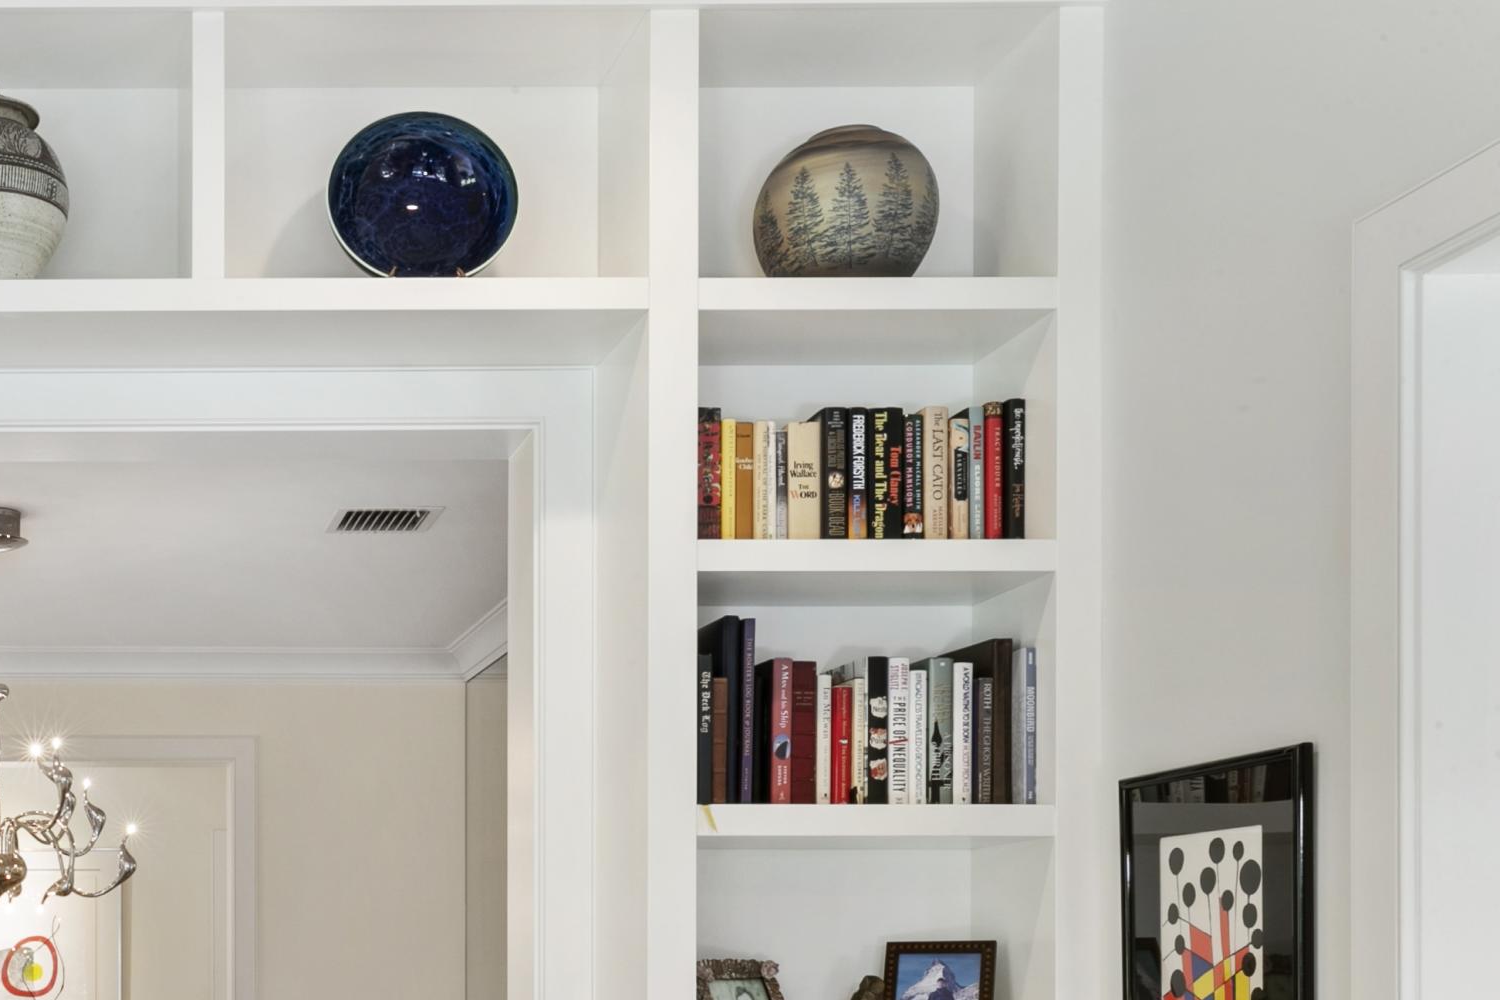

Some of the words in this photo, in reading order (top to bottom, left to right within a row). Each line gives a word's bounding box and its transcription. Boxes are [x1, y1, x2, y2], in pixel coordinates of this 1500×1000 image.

[875, 412, 888, 431] The
[933, 412, 944, 426] The
[852, 415, 865, 455] FREDERICK
[875, 433, 887, 458] Bear
[932, 429, 944, 461] LAST
[875, 460, 888, 479] and
[890, 446, 901, 468] Tom
[852, 456, 865, 490] FORSYTH
[932, 464, 944, 500] CATO
[875, 481, 887, 500] The
[888, 471, 901, 505] Clancy
[829, 493, 844, 513] BOOK
[829, 516, 844, 536] DEAD
[872, 503, 887, 539] Dragon
[701, 691, 710, 712] Deck
[1027, 686, 1035, 732] MOONBIRD
[700, 715, 710, 733] Log
[893, 702, 906, 727] PRICE
[892, 743, 906, 792] INEQUALITY
[983, 768, 991, 803] WRITER
